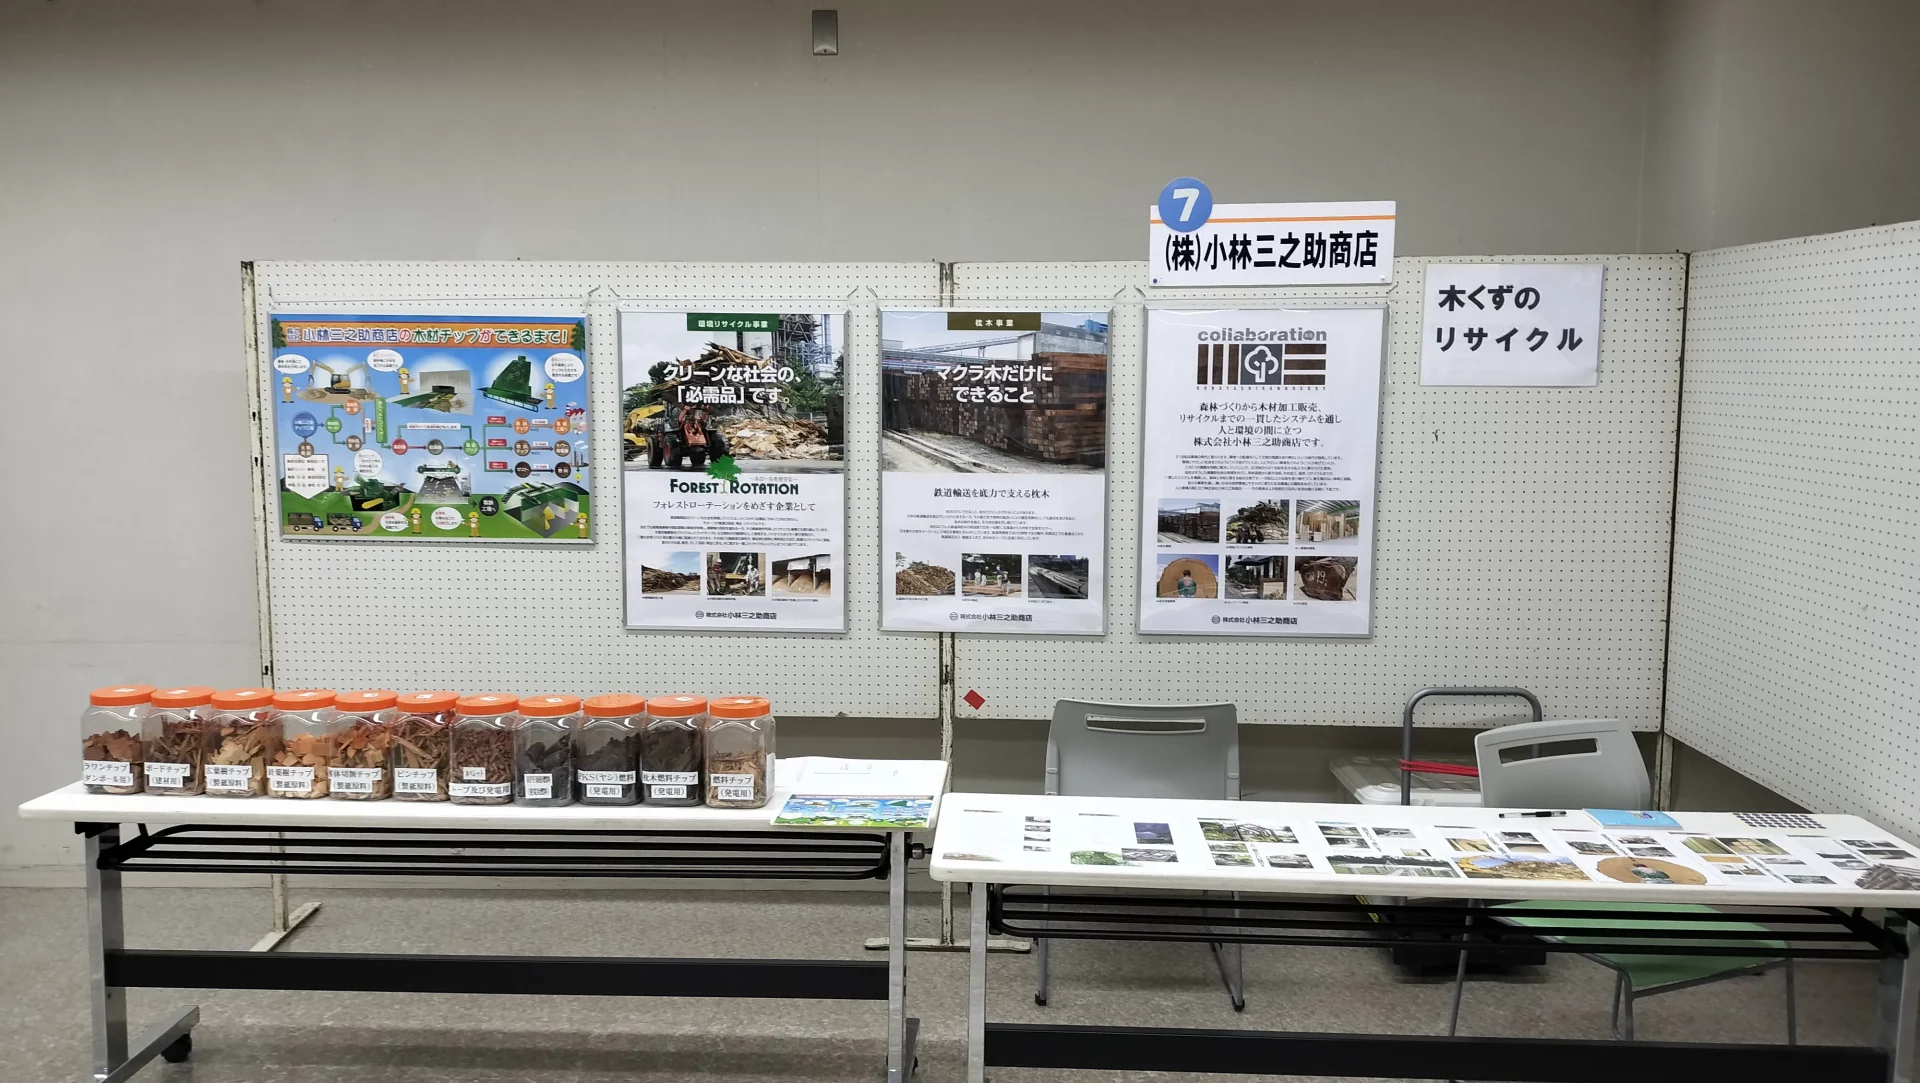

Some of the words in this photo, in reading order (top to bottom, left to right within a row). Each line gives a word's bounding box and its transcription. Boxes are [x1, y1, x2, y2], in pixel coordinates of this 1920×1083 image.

[1172, 188, 1200, 222] 7
[1165, 230, 1379, 273] (株)小林三之助商店
[1438, 284, 1541, 312] 木くずの
[698, 320, 768, 328] 環境リサイクル事業
[1197, 327, 1327, 341] collaboration
[1435, 326, 1584, 353] リサイクル
[663, 365, 801, 383] クリーンな社会の、
[934, 365, 1053, 382] マクラ木だけに
[677, 386, 790, 404] 「必需品」です。
[953, 386, 1035, 403] できること
[1199, 402, 1322, 413] 森林づくりから木材加工販売、
[1179, 414, 1342, 424] リサイクルまでの一貫したシステムを通し
[1218, 426, 1302, 436] 人と環境の間に立つ
[1193, 437, 1324, 448] 株式会社小林三之助商店です。
[934, 487, 1050, 499] 鉄道輸送を底力で支える枕木
[653, 501, 816, 512] フォレストローテーションをめざす企業として
[84, 762, 129, 772] ラワンチップ
[713, 775, 753, 785] 燃料チップ
[589, 786, 620, 796] (発電用)
[653, 786, 685, 796] (発電用)
[720, 788, 752, 798] (発電用)
